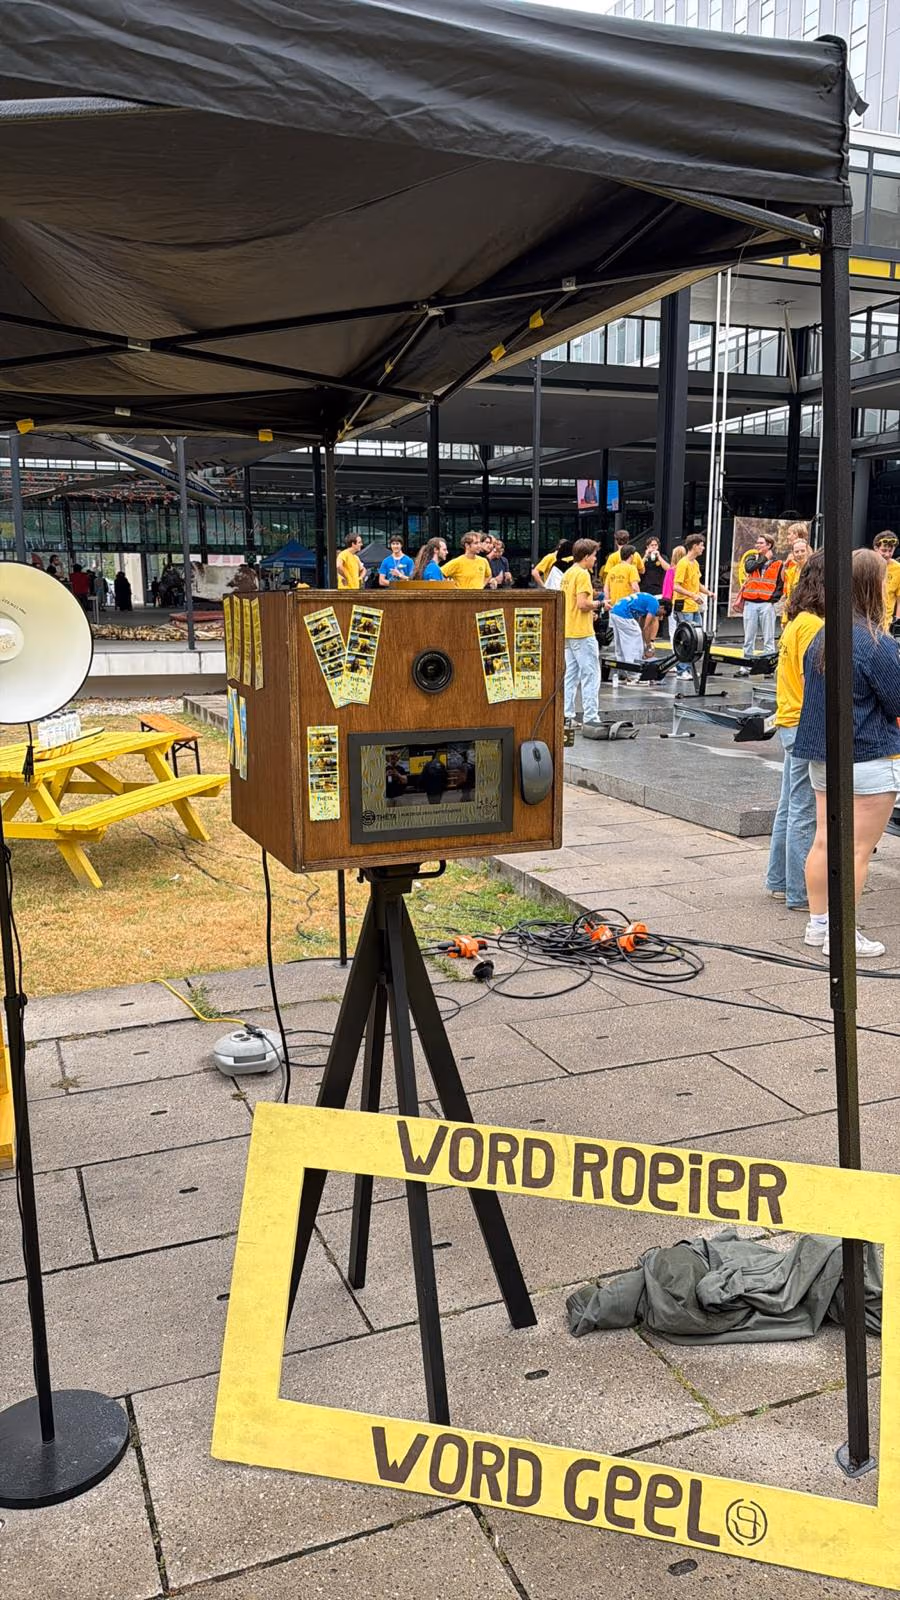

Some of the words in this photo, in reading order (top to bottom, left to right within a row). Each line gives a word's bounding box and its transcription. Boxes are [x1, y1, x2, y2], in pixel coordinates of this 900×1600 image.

[492, 676, 507, 684] THETA
[377, 812, 397, 821] THETA
[396, 1120, 555, 1189] WORD
[371, 1426, 543, 1508] WORD
